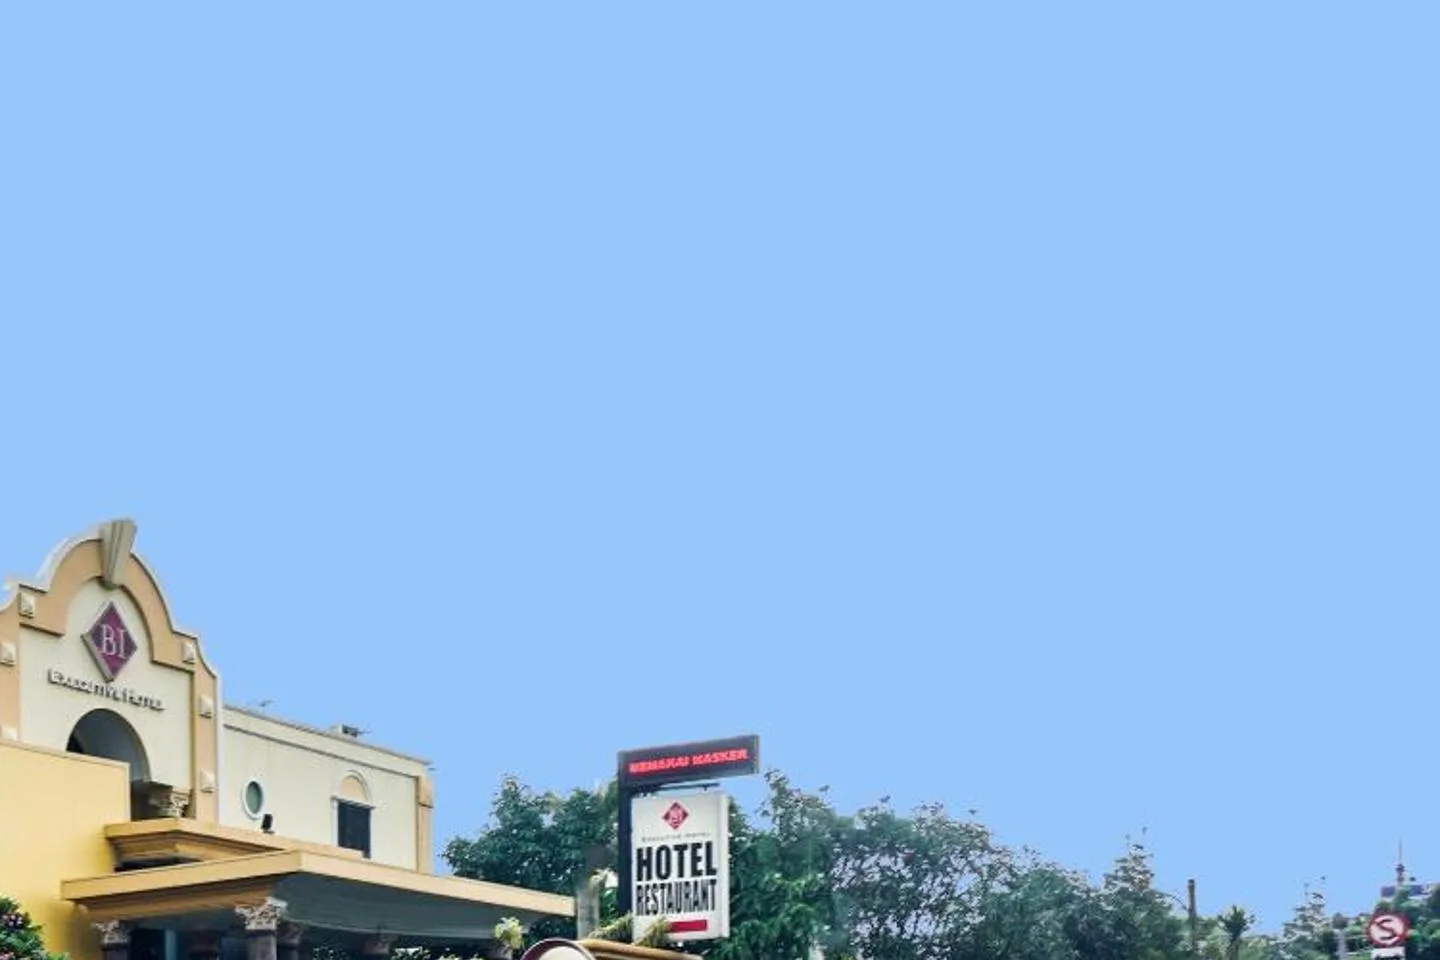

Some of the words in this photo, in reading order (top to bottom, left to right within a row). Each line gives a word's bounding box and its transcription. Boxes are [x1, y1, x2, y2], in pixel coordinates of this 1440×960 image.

[101, 624, 127, 659] BI
[637, 840, 718, 881] HOTEL
[637, 880, 717, 915] RESTAURANT
